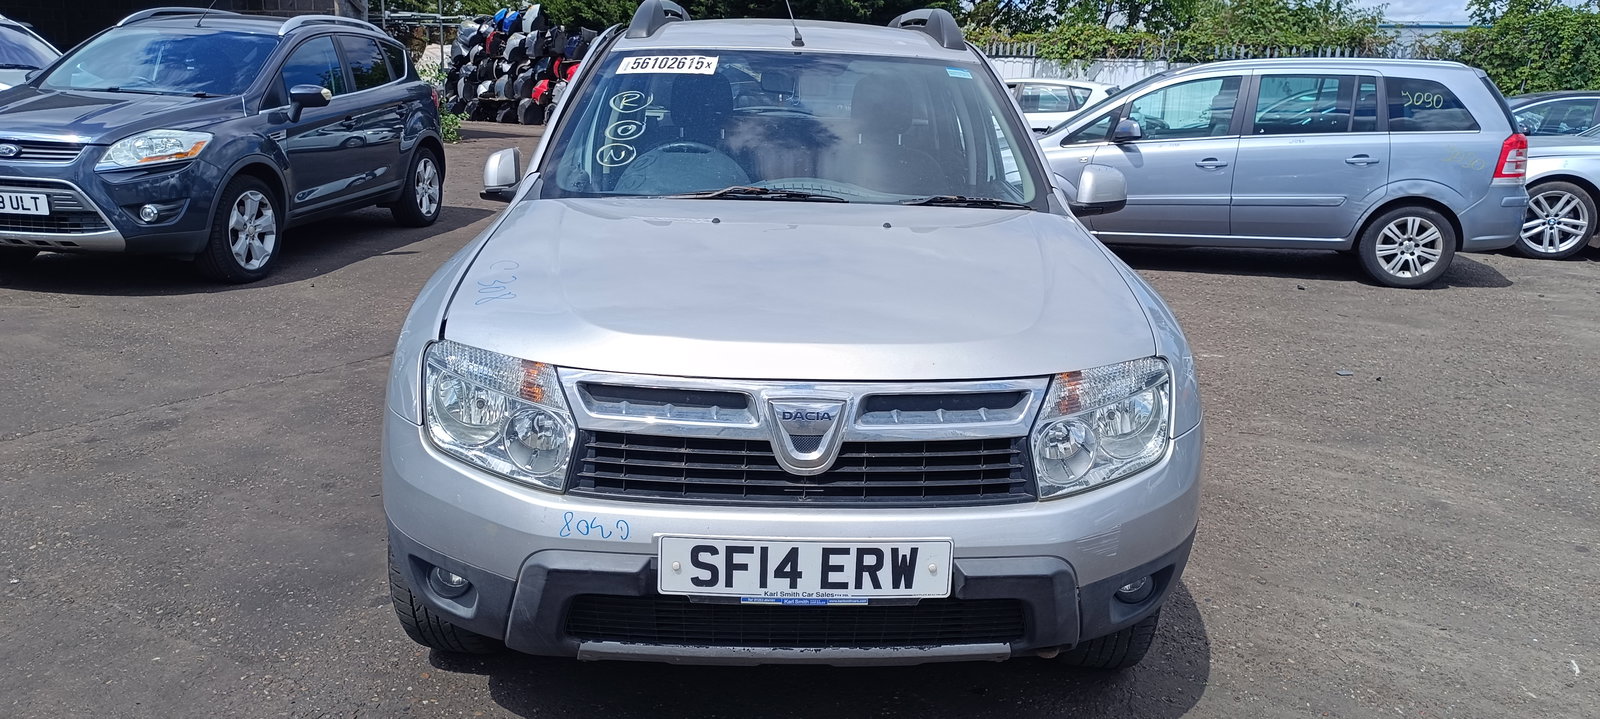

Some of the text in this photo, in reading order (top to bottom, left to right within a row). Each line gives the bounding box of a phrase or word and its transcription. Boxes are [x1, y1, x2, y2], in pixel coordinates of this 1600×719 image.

[9, 195, 39, 211] ULT
[782, 411, 832, 421] DACIA
[690, 544, 919, 590] SF14 ERW
[779, 590, 800, 598] Smith
